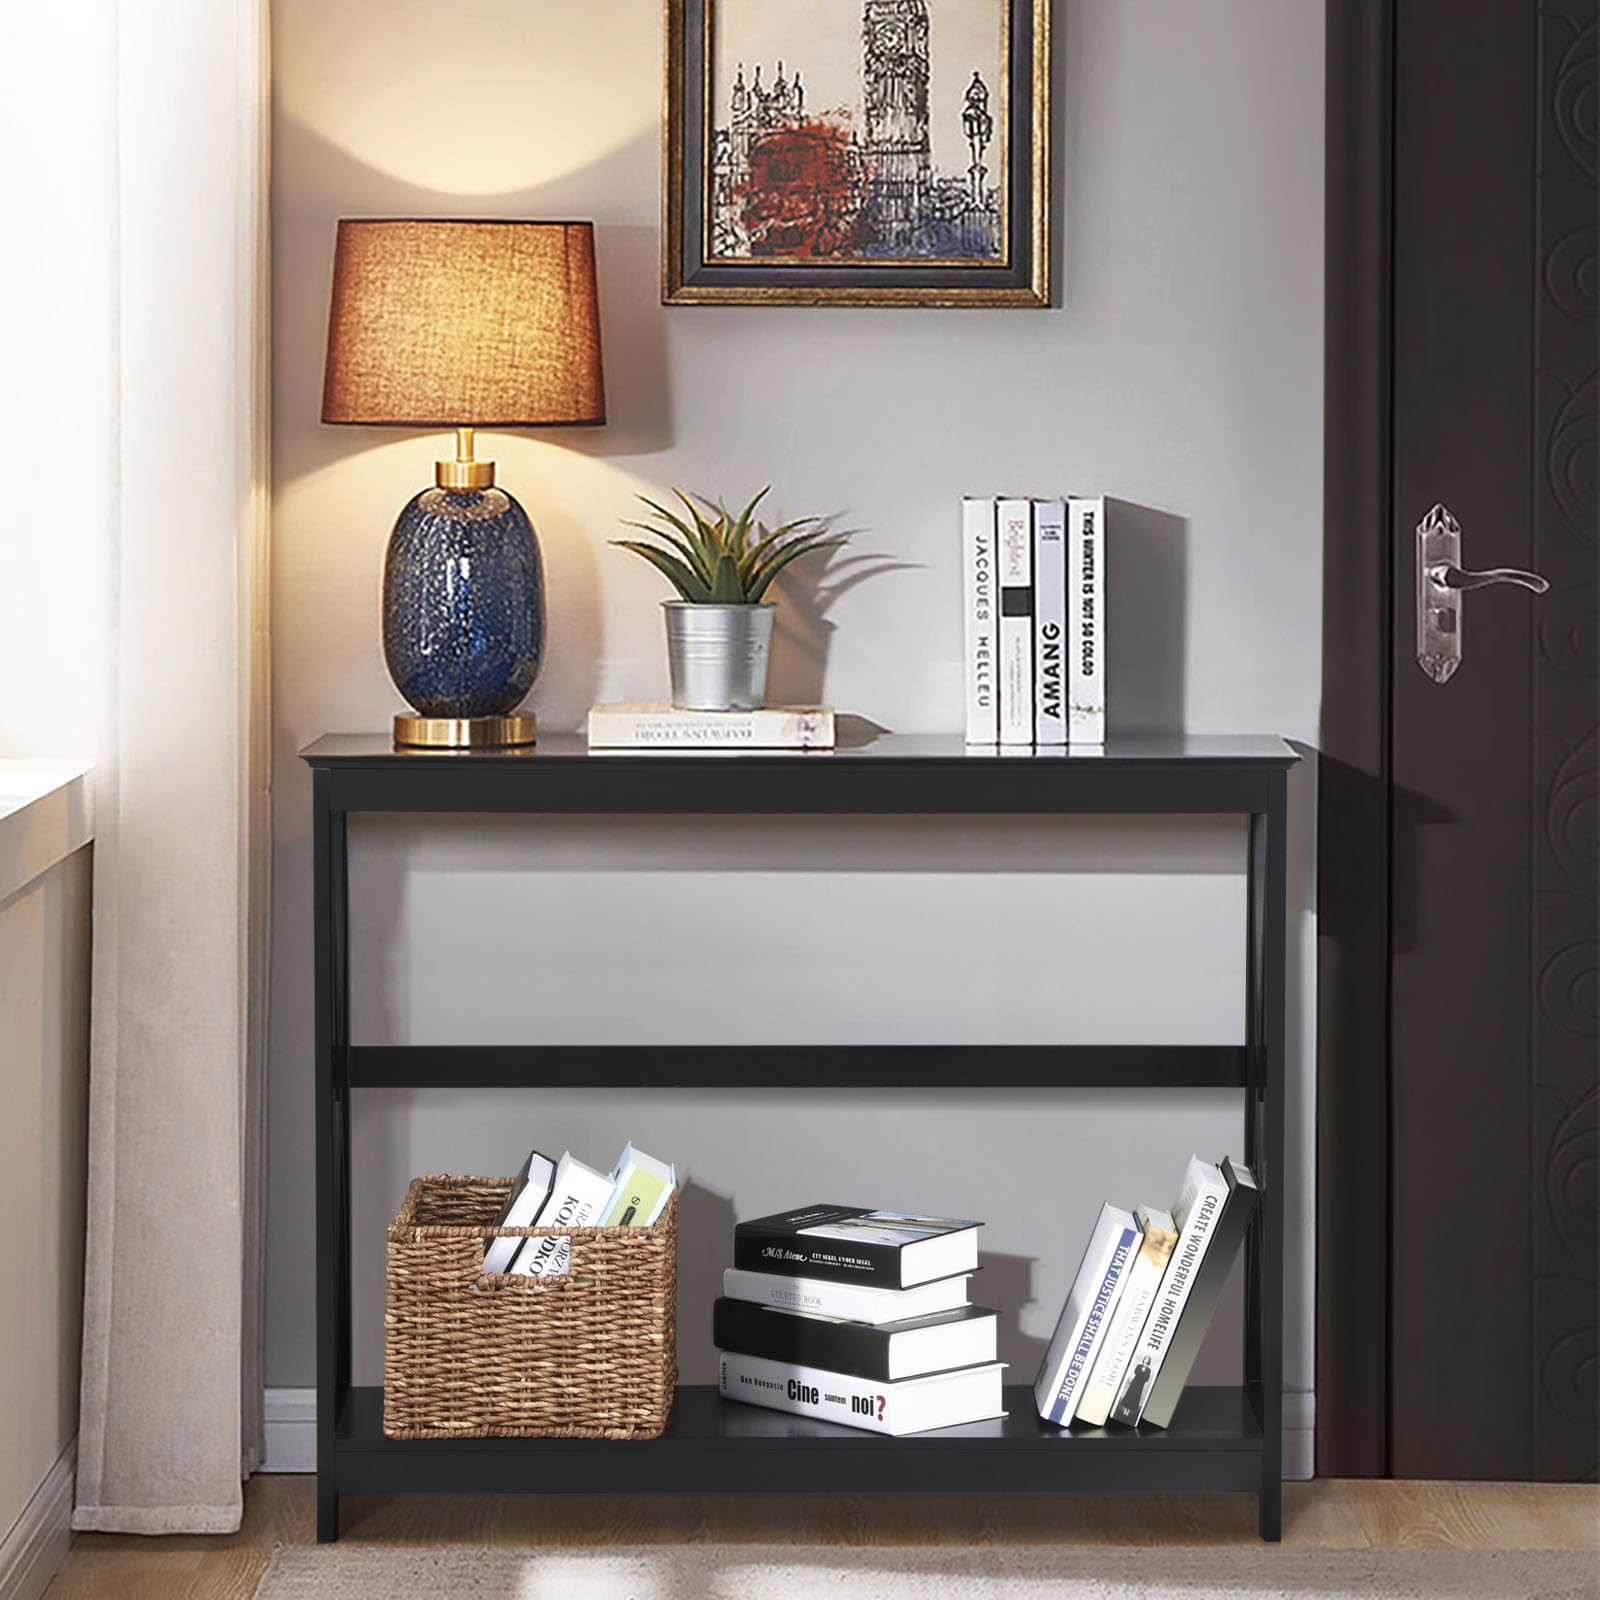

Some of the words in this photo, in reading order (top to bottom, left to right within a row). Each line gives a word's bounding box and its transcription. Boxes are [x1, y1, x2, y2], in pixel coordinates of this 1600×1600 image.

[1082, 511, 1095, 536] THIS
[975, 535, 990, 620] JACQUES
[1082, 583, 1095, 595] IS
[975, 636, 990, 707] HELLEU
[1041, 623, 1061, 719] AMANG
[1194, 1195, 1218, 1234] CREATE
[1109, 1245, 1131, 1276] THAT
[1168, 1234, 1202, 1298] WONDERFUL
[1092, 1275, 1117, 1320] JUSTICE
[1077, 1319, 1099, 1352] SHALL
[1147, 1299, 1177, 1350] HOMELIFE
[1071, 1353, 1086, 1369] BE
[787, 1378, 820, 1405] Cine
[851, 1394, 887, 1422] noi?
[1058, 1369, 1079, 1401] DONE
